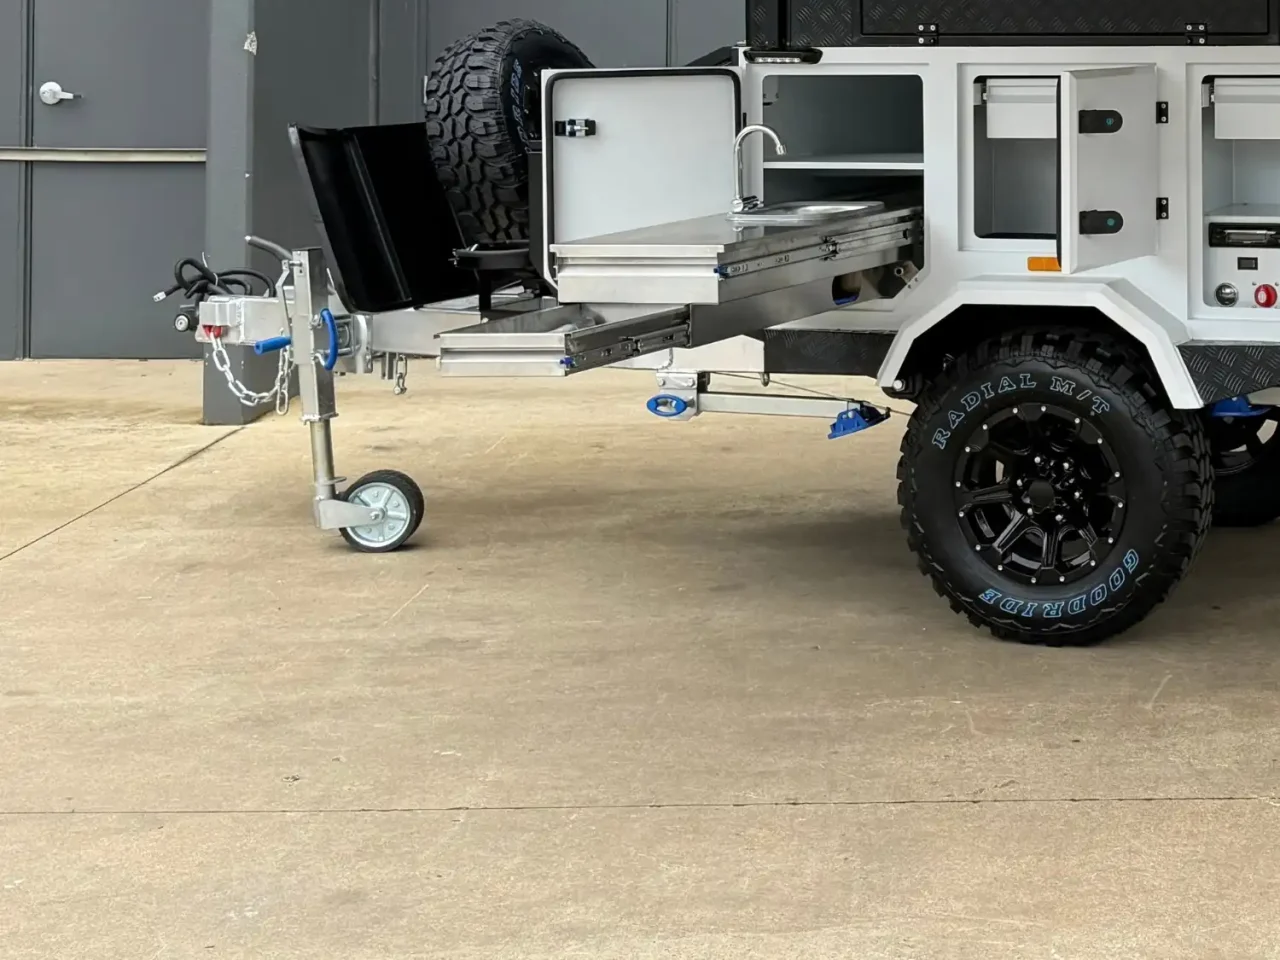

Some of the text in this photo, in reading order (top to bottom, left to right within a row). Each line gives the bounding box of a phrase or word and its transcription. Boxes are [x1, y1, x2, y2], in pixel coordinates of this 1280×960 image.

[932, 373, 1111, 450] RADIAL M/T
[980, 548, 1140, 619] GOODRIDE
